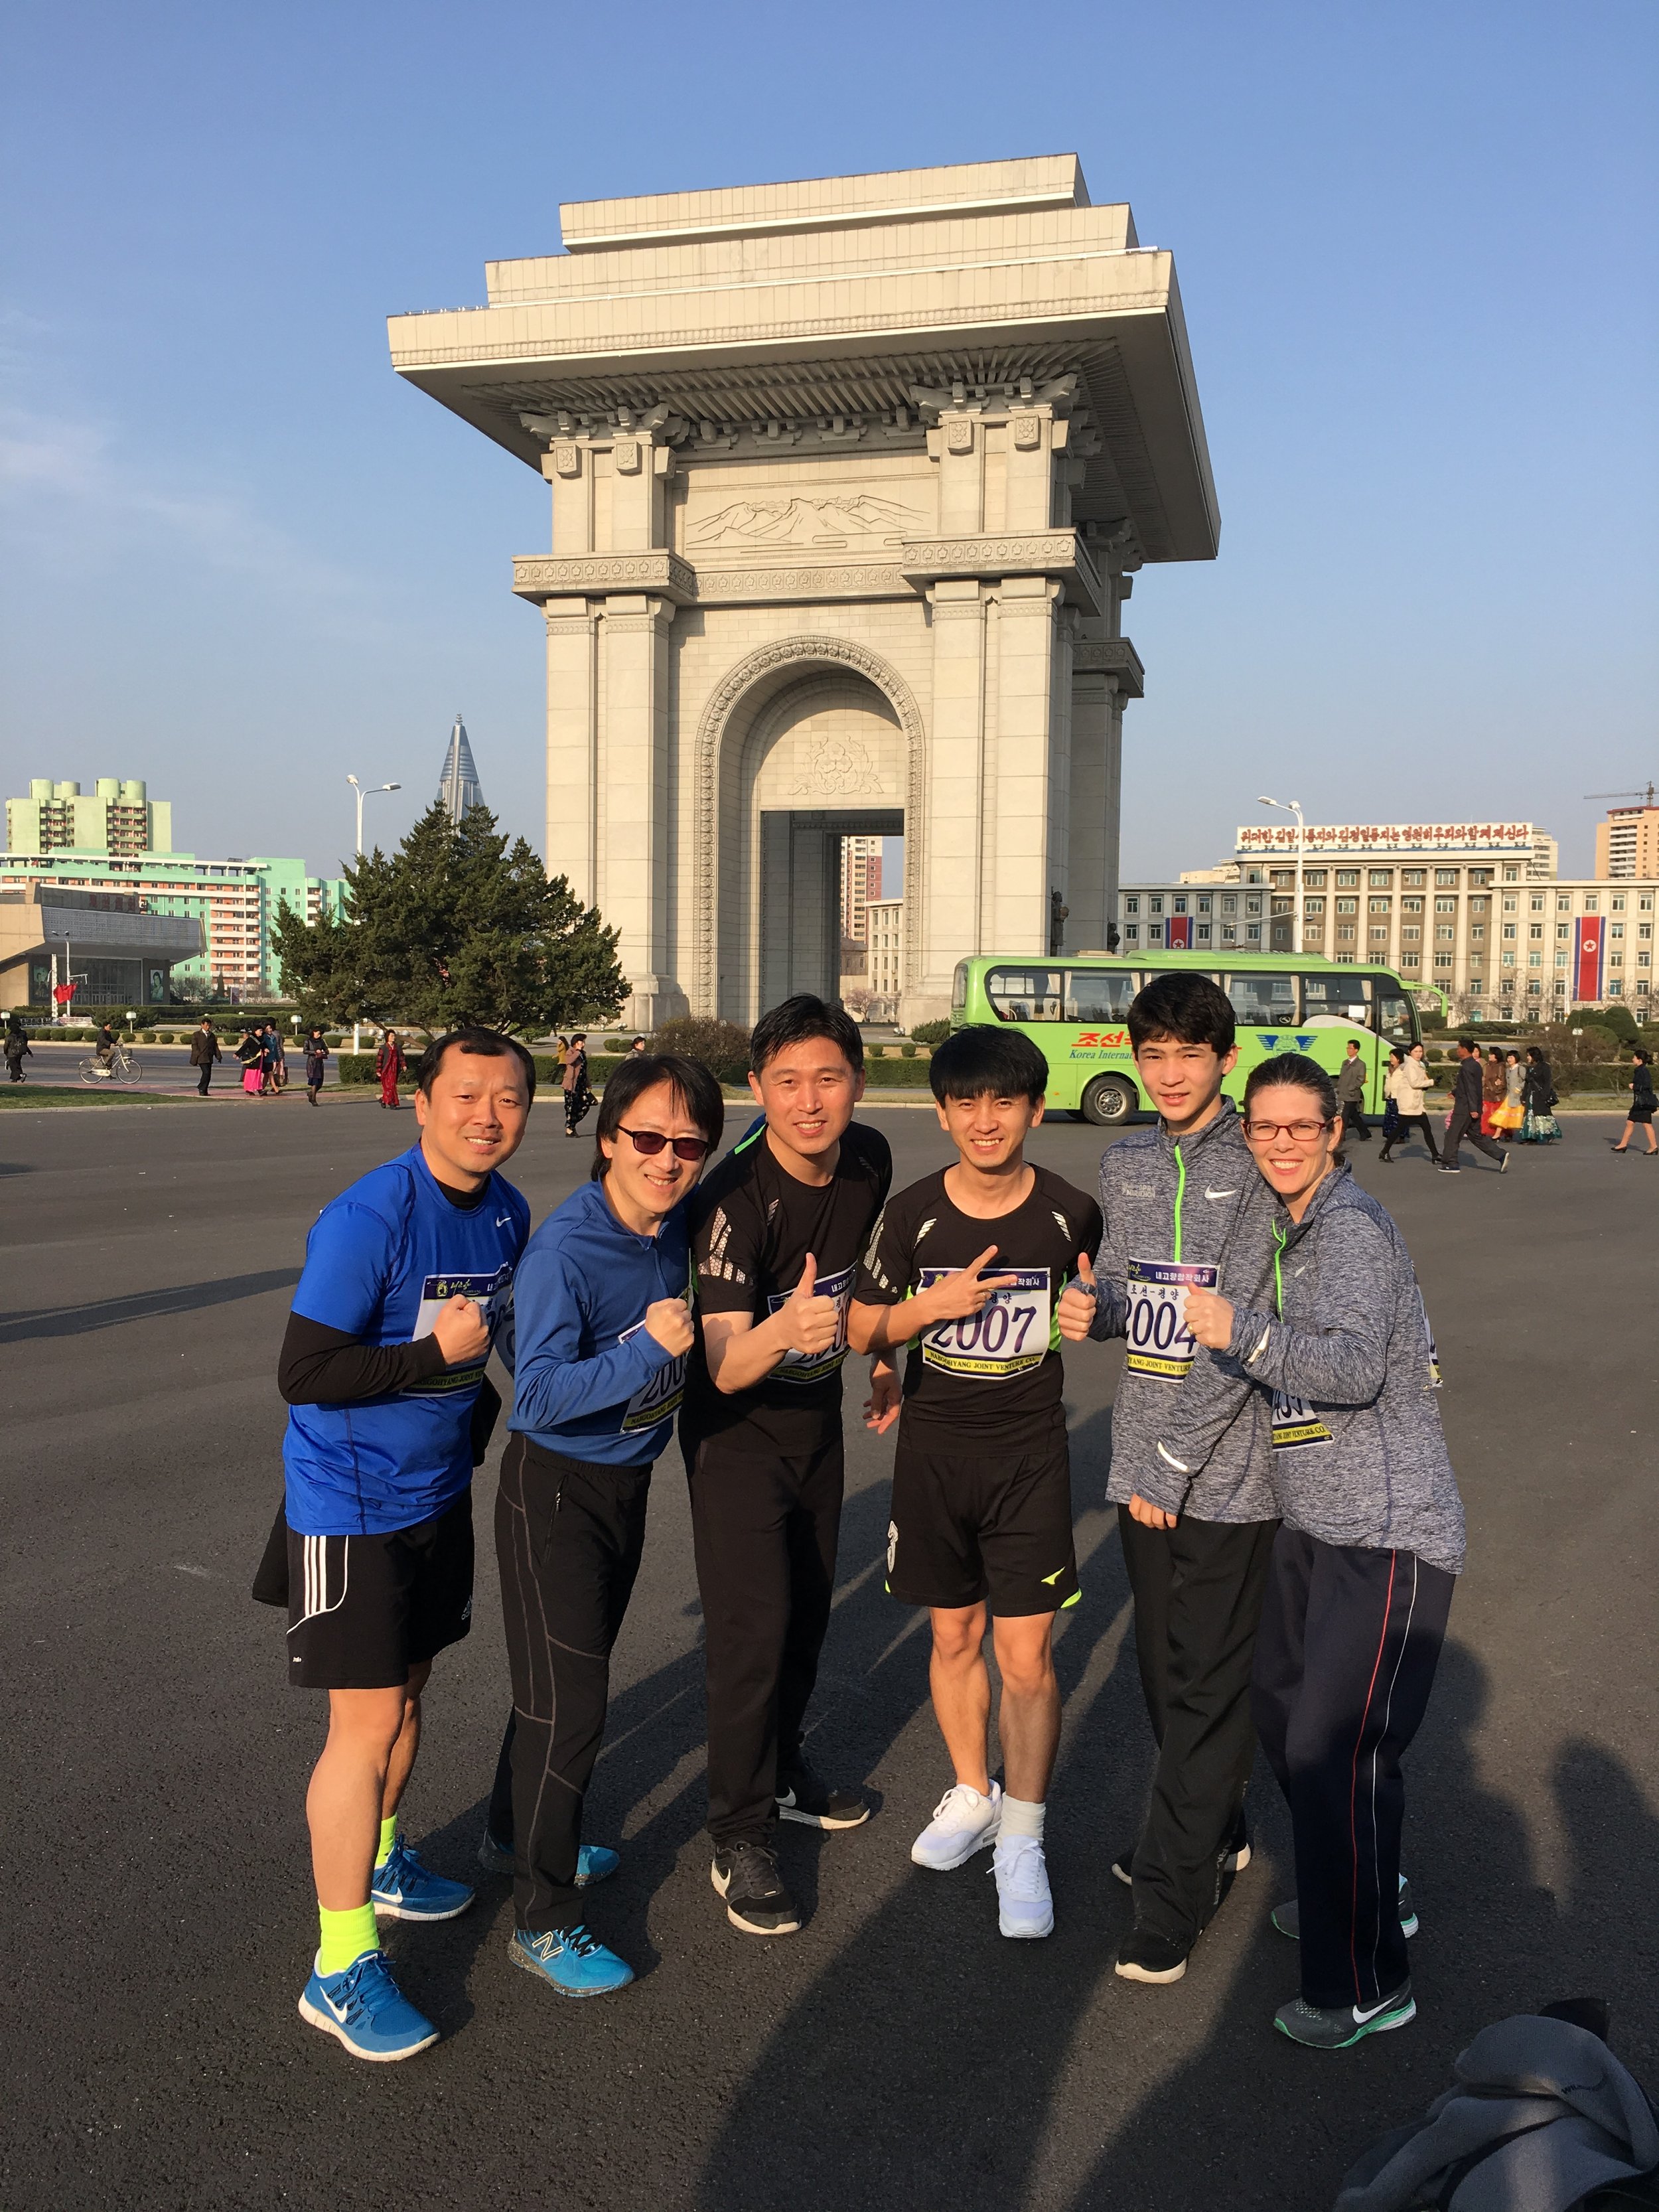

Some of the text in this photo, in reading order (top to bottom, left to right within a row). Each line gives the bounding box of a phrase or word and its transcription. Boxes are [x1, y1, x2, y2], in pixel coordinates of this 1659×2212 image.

[1241, 829, 1273, 844] 위대한
[1069, 1049, 1096, 1059] Korea
[1155, 1271, 1210, 1283] 내고향합작회사
[930, 1305, 1037, 1353] 2007
[930, 1351, 972, 1368] NAEGOHYANG
[996, 1360, 1024, 1370] VENTURE
[1145, 1360, 1163, 1369] JOINT
